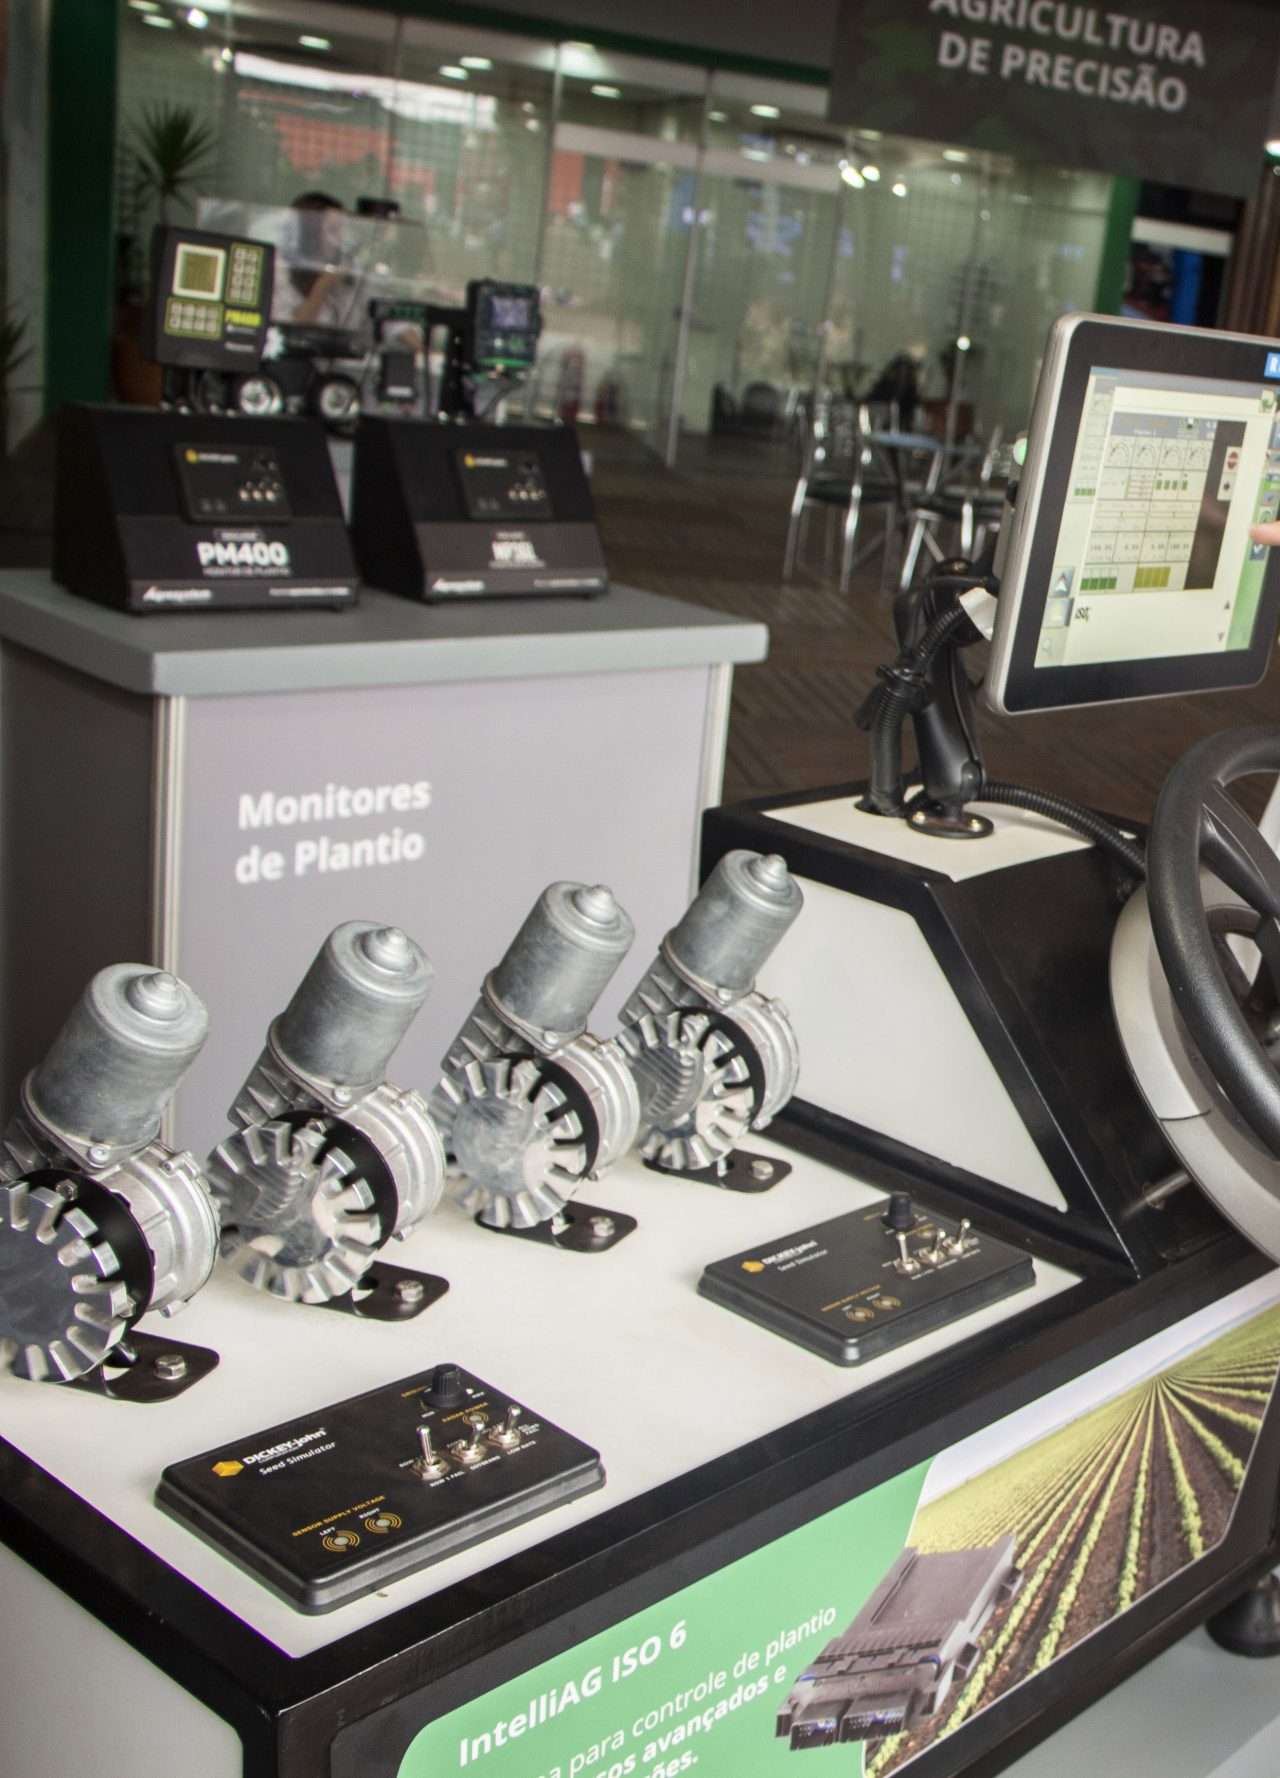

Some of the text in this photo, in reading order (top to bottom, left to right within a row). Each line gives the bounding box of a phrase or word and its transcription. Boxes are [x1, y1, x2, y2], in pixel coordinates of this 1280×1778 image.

[937, 31, 1188, 112] DE PRECISÃO
[197, 541, 289, 566] PM400
[238, 781, 431, 830] Monitores
[235, 827, 425, 884] de Plantio
[242, 1429, 328, 1465] DICKEY-john
[258, 1441, 337, 1476] Seed Simulator
[291, 1520, 324, 1538] SENSOR
[323, 1508, 352, 1525] SUPPLY
[319, 1526, 336, 1537] LEFT
[458, 1620, 687, 1767] IntelliAG ISO 6
[569, 1729, 625, 1778] para
[632, 1670, 726, 1738] controle
[732, 1649, 760, 1680] de
[765, 1606, 837, 1666] plantio
[642, 1677, 769, 1763] avançados
[773, 1663, 788, 1685] e
